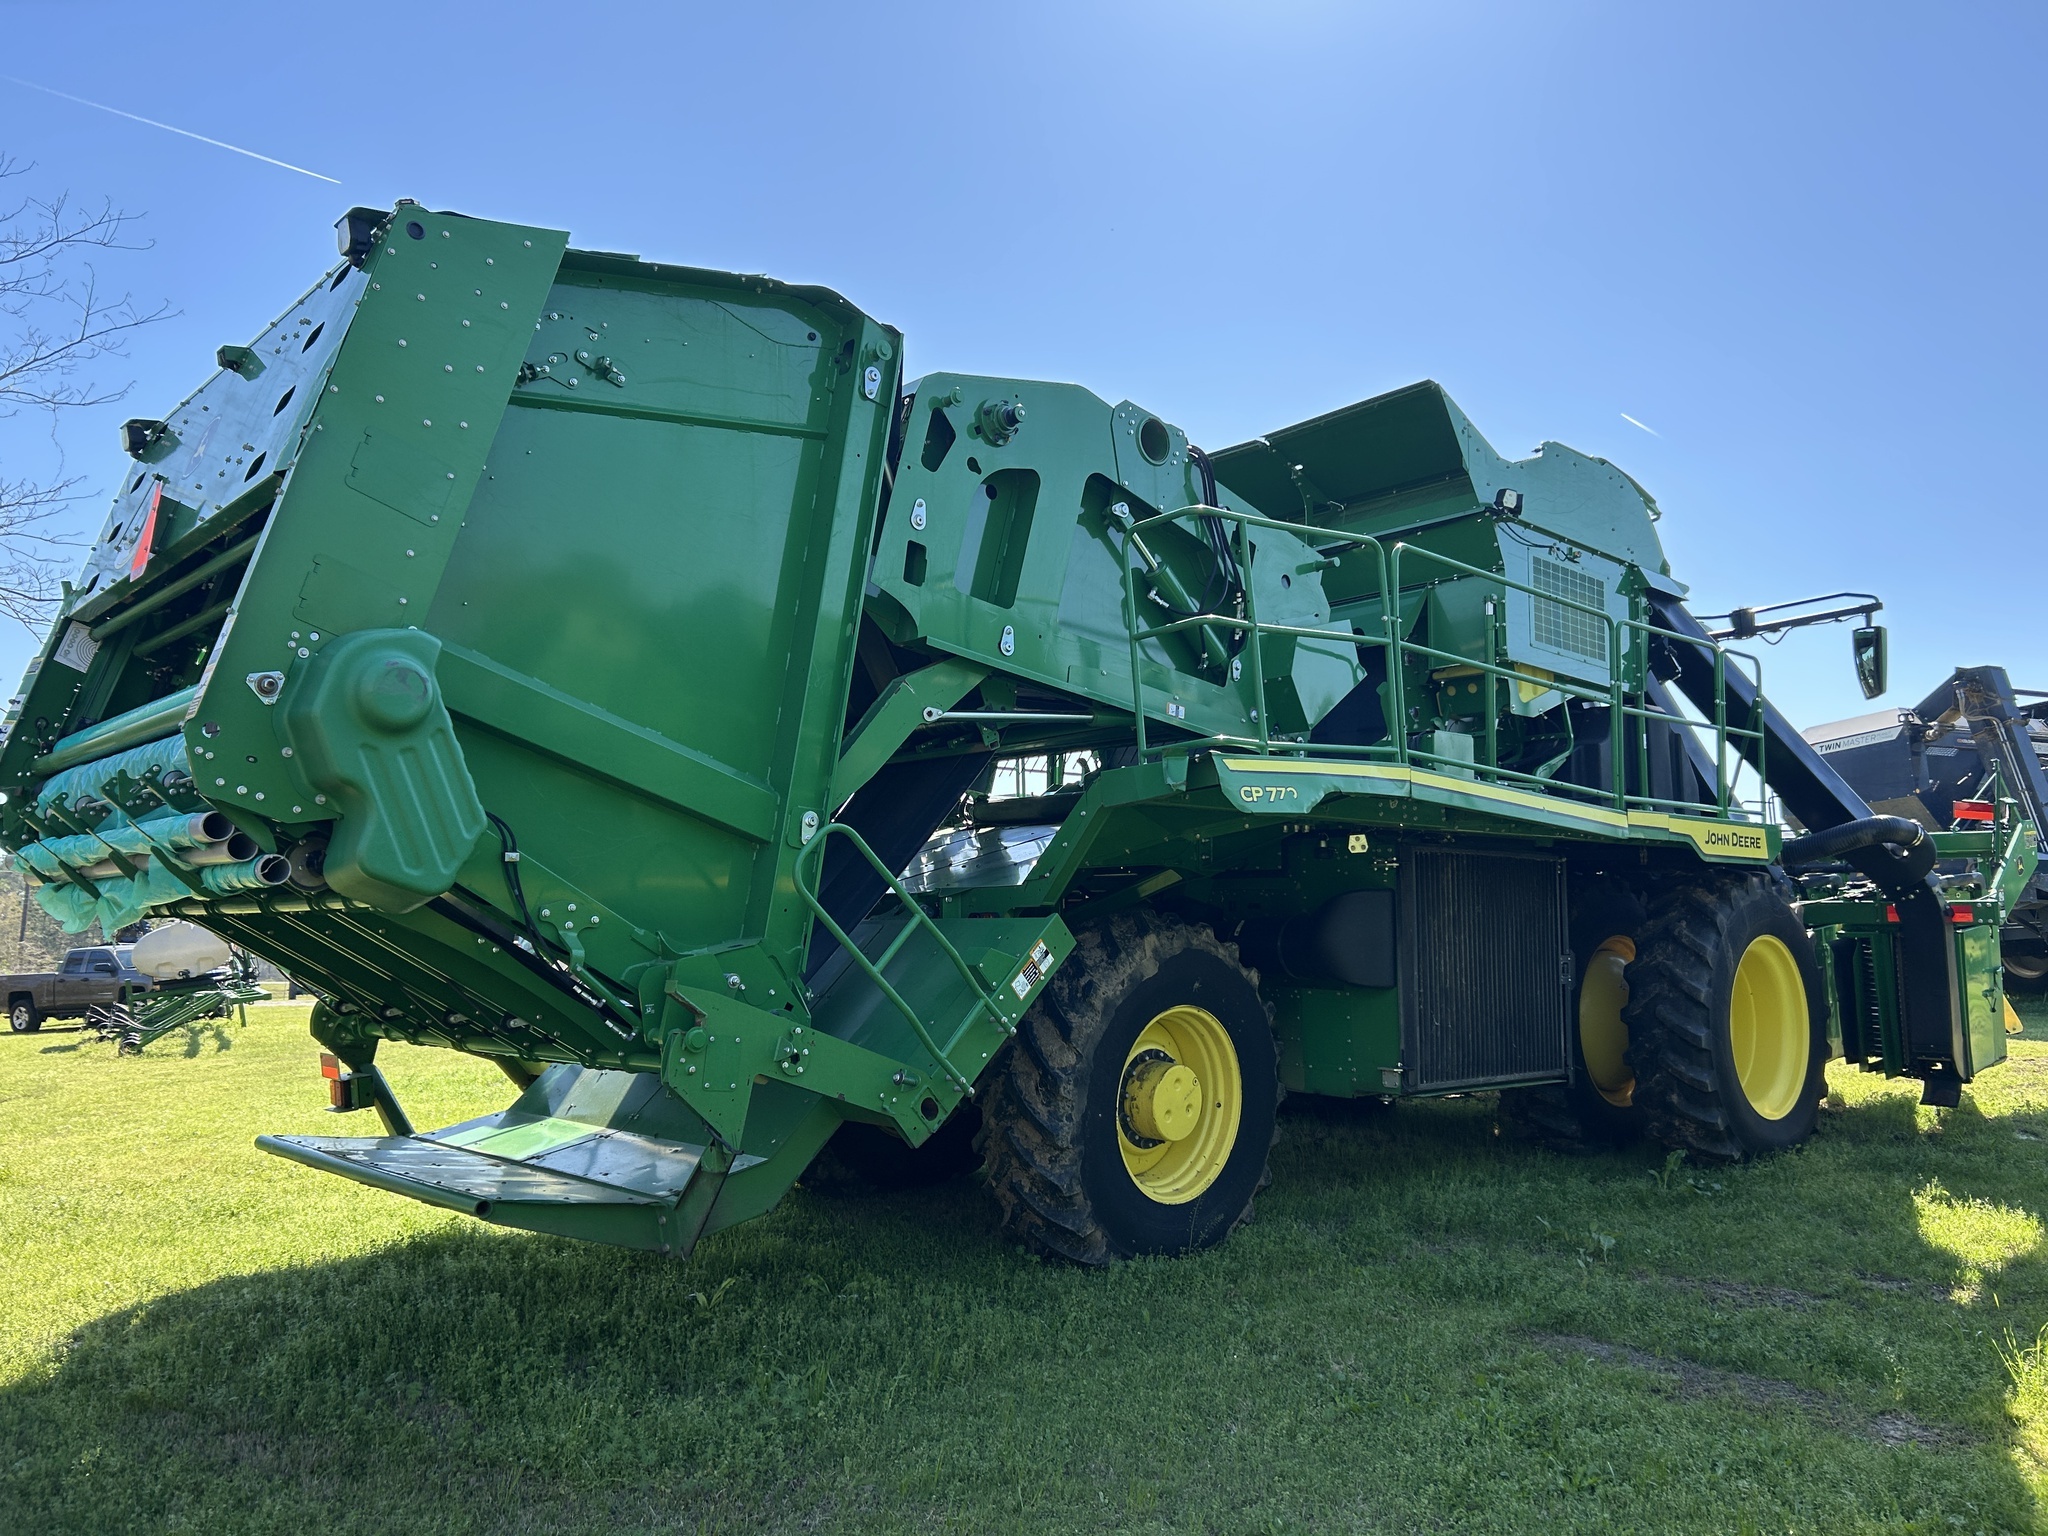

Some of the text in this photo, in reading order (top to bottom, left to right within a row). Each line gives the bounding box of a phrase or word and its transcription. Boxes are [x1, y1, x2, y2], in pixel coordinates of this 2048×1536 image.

[1819, 741, 1841, 753] TWIN
[1842, 734, 1877, 747] MASTER
[1240, 786, 1264, 802] CP
[1705, 829, 1762, 849] JOHN DEERE
